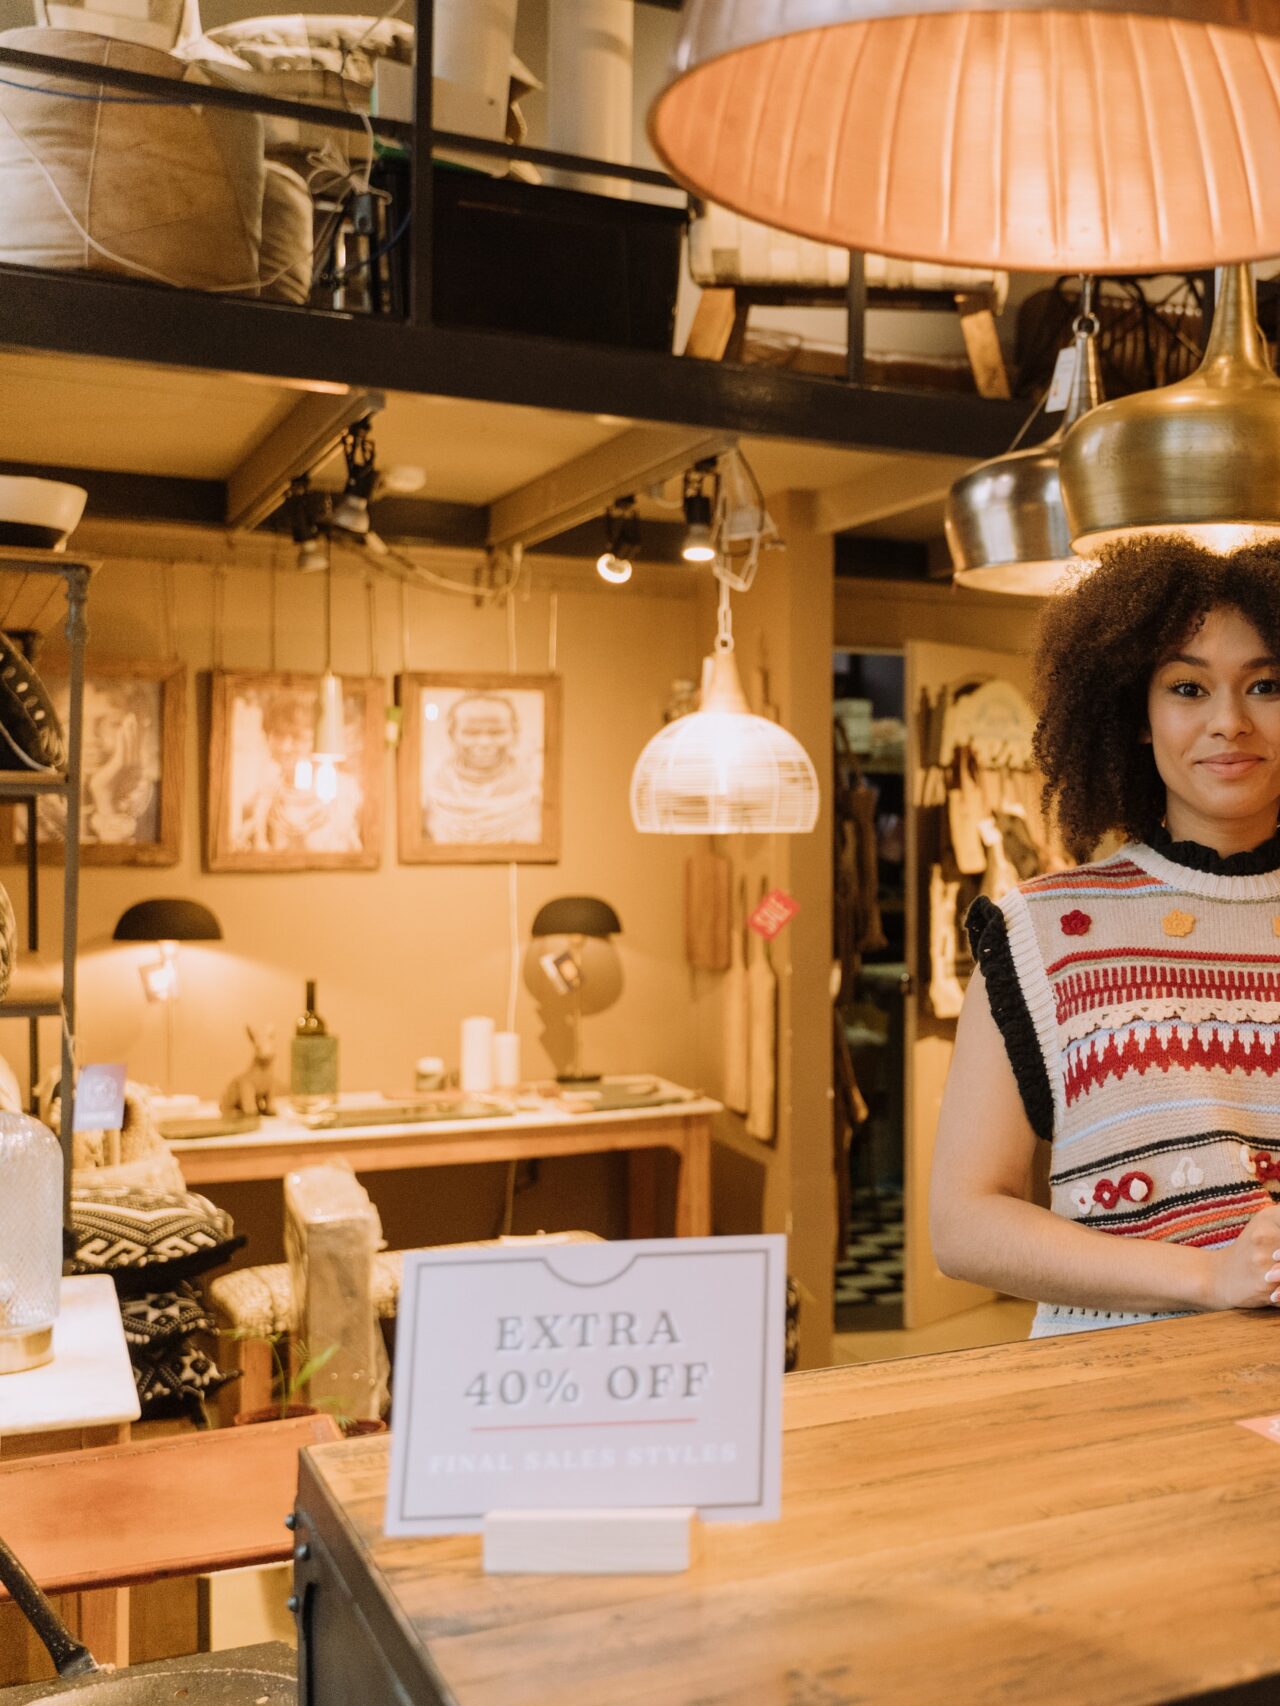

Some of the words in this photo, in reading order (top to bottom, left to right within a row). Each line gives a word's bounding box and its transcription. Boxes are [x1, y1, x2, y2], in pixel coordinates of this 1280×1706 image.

[494, 1310, 684, 1353] EXTRA
[464, 1367, 581, 1408] 40%
[606, 1362, 710, 1403] OFF
[429, 1453, 513, 1476] FINAL
[523, 1448, 616, 1471] SALES
[625, 1442, 738, 1466] STYLES
